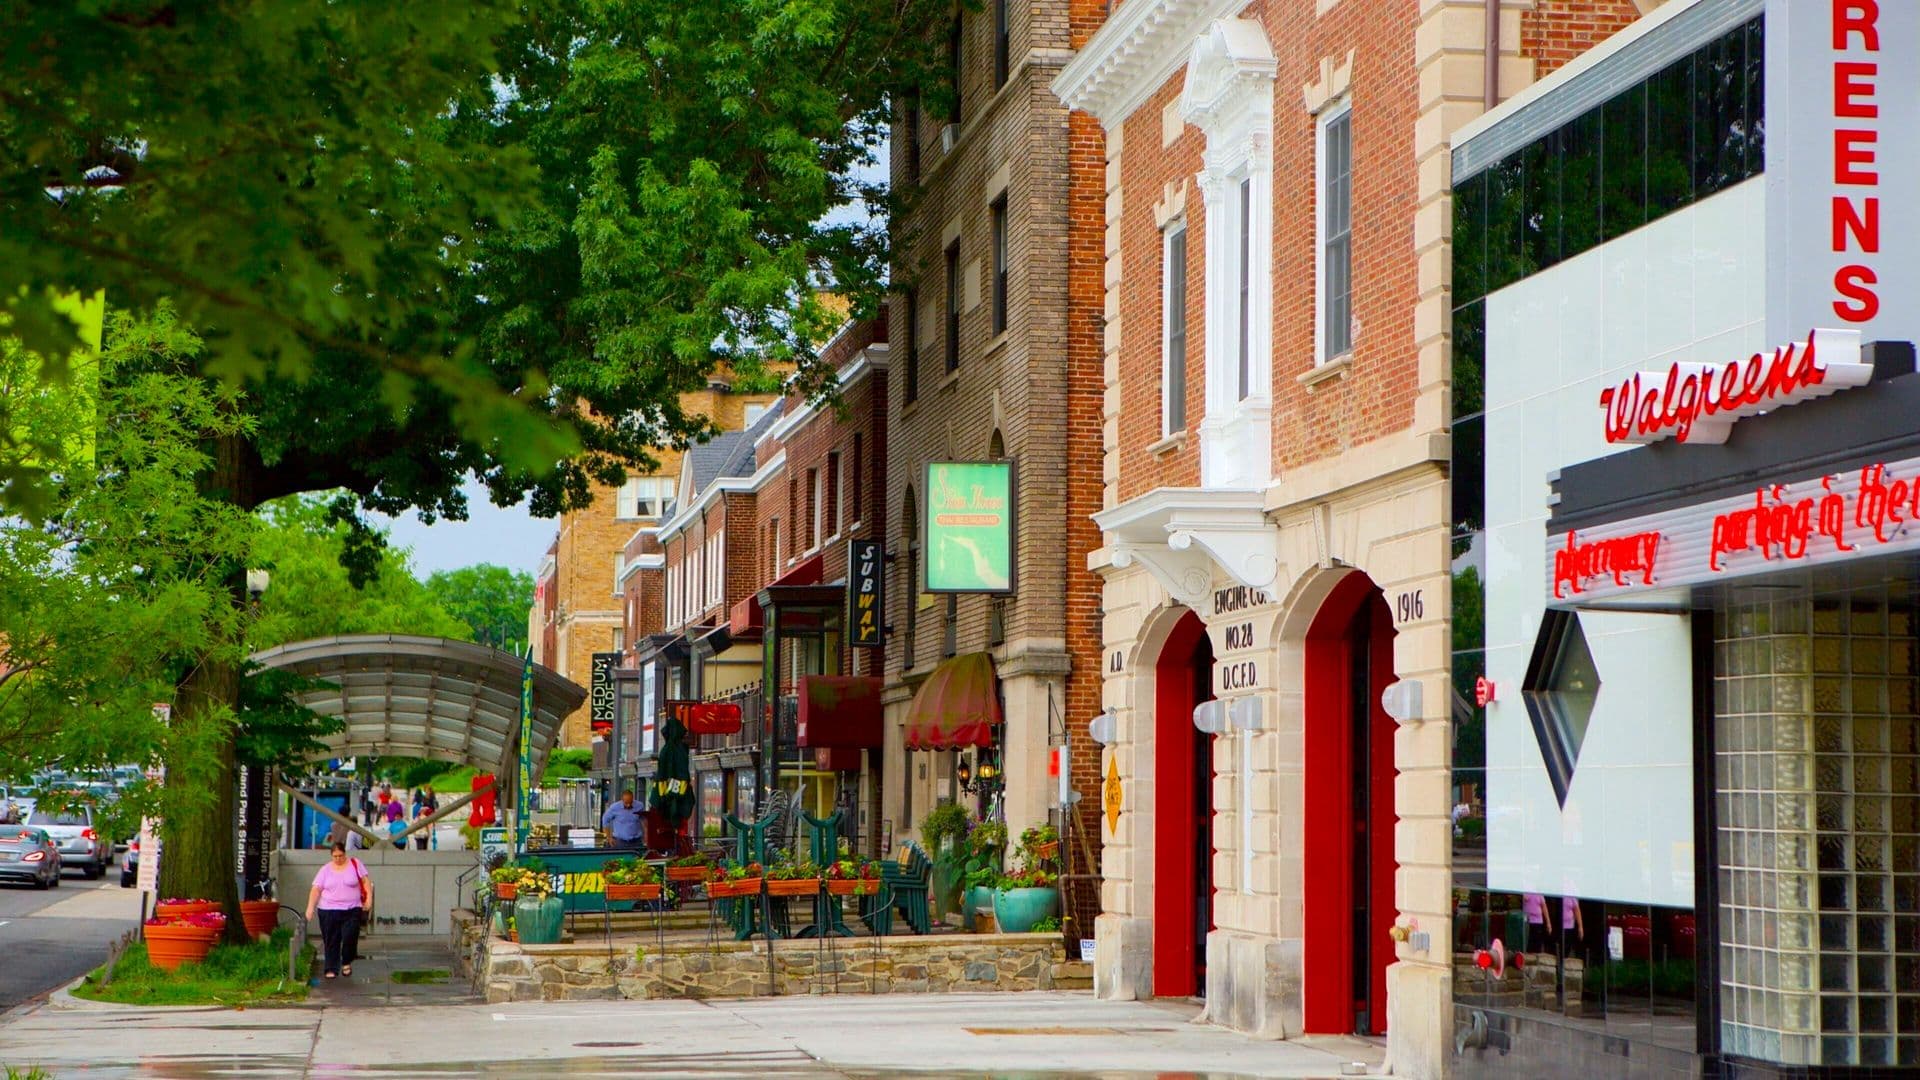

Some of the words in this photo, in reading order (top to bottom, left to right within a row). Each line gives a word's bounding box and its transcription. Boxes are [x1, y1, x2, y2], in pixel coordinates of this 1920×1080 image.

[1600, 328, 1828, 444] Walgreens
[1710, 484, 1815, 571] parking
[1819, 474, 1853, 551] in
[1856, 461, 1904, 543] the
[1554, 528, 1661, 599] pharmacy
[858, 545, 876, 641] SUBWAY
[1214, 585, 1248, 615] ENGINE
[1397, 589, 1424, 623] 1916
[1110, 650, 1124, 673] A.D.
[1223, 661, 1258, 690] D.C.F.D.
[593, 658, 606, 720] MEDIUM
[239, 799, 248, 826] Park
[262, 800, 272, 827] Park
[237, 829, 248, 873] Station
[260, 829, 271, 873] Station
[377, 915, 396, 925] Park
[399, 915, 430, 925] Station
